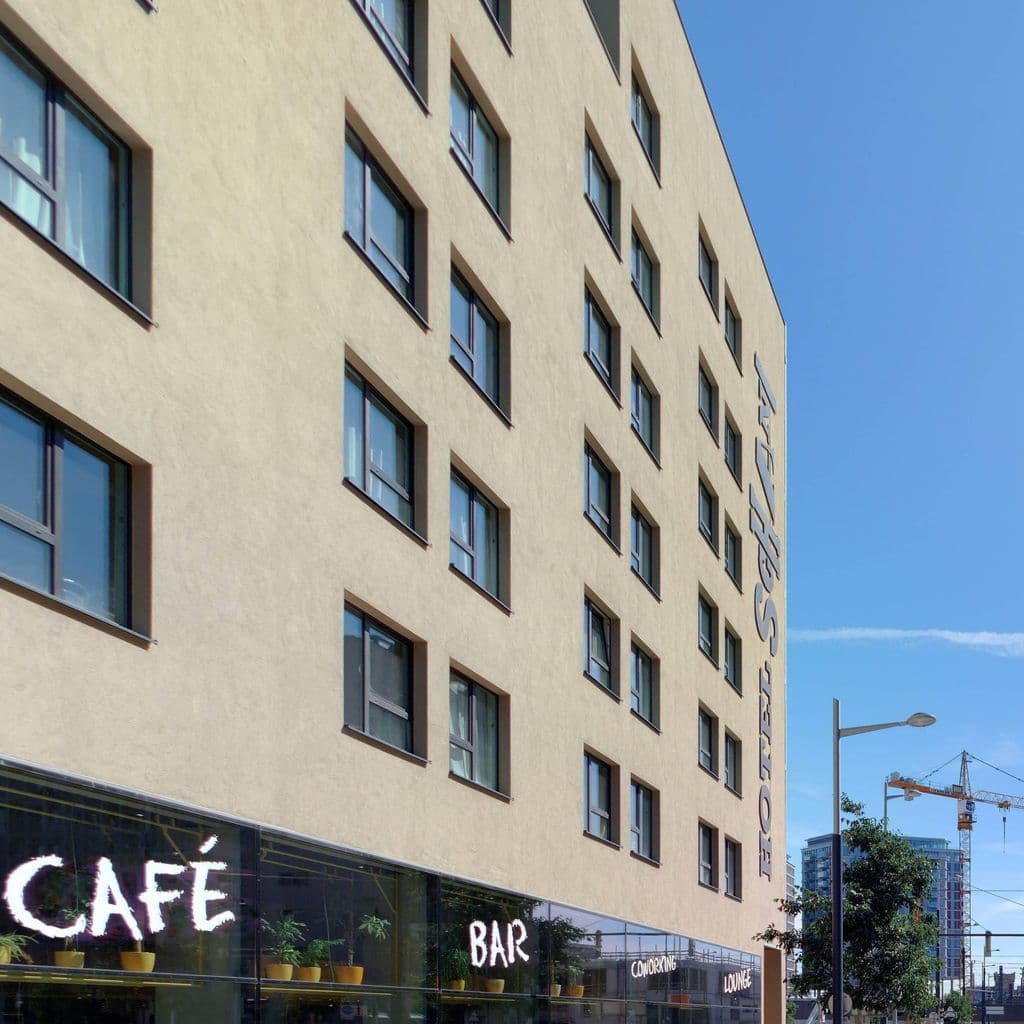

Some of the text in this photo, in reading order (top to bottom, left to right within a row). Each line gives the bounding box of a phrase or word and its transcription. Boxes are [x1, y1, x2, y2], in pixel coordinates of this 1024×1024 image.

[758, 660, 772, 882] HOTEL
[4, 834, 236, 940] CAFÉ
[469, 918, 530, 968] BAR
[631, 955, 677, 978] COWORKING
[724, 968, 753, 993] LOUNGE
